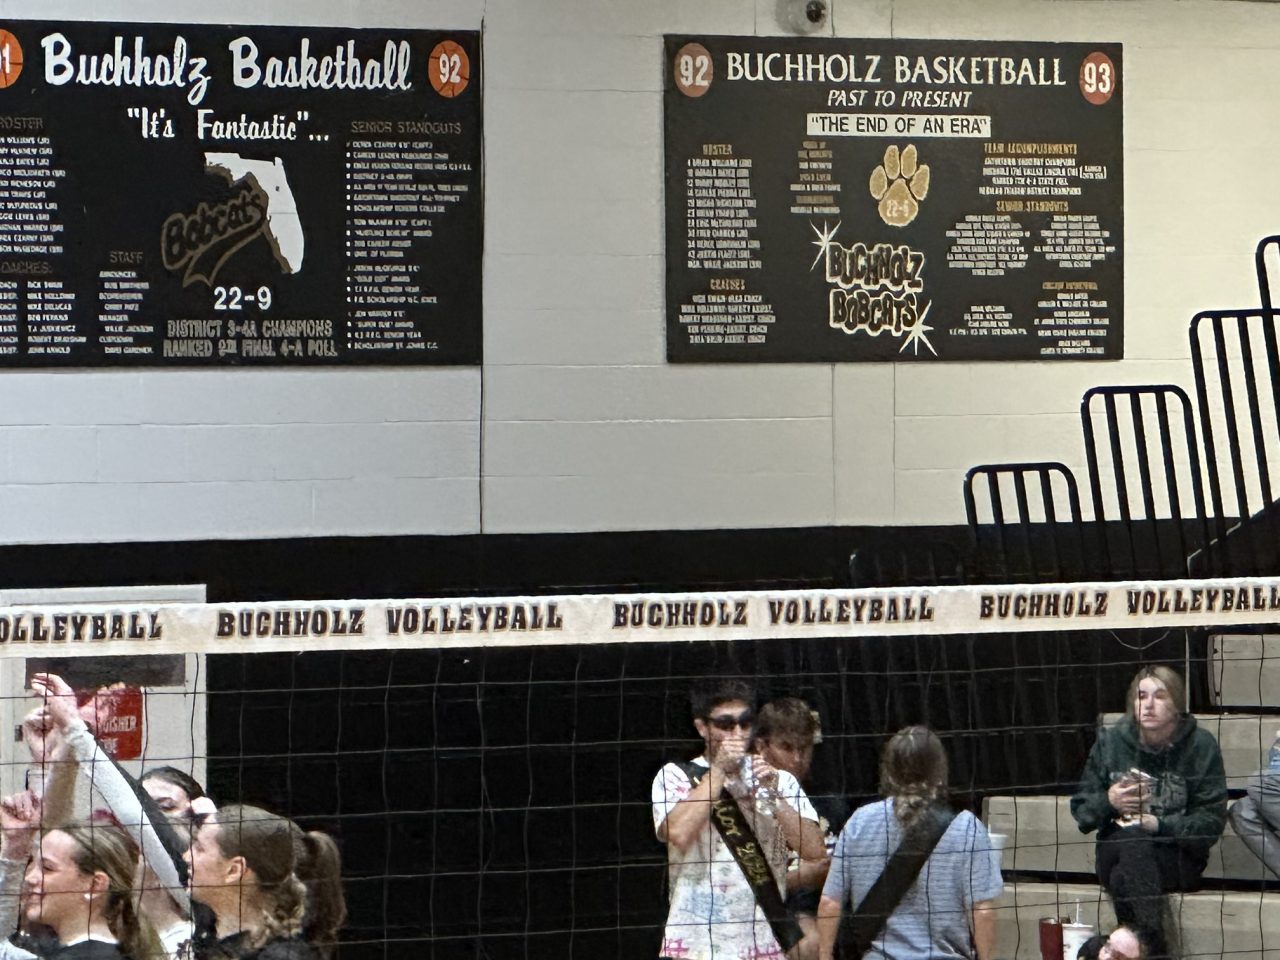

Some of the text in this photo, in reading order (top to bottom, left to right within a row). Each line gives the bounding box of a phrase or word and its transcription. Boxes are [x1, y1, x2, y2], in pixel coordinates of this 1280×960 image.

[40, 33, 411, 104] Buchholz Basketball
[439, 53, 463, 84] 92
[679, 54, 709, 86] 92
[726, 52, 1066, 87] BUCHHOLZ BASKETBALL
[1083, 62, 1111, 94] 93
[827, 90, 972, 108] PAST TO PRESENT
[127, 106, 175, 139] "It's
[811, 115, 987, 135] "THE END OF AN ERA"
[826, 242, 924, 292] BUCHHOLZ
[214, 286, 272, 310] 22-9
[830, 289, 917, 336] BOBCATS
[167, 320, 222, 337] DISTRICT
[262, 320, 333, 338] CHAMPIONS
[216, 608, 364, 640] BUCHHOLZ
[386, 603, 564, 635] VOLLEYBALL
[612, 601, 749, 629] BUCHHOLZ
[769, 596, 935, 625] VOLLEYBALL
[980, 591, 1108, 619] BUCHHOLZ
[1127, 585, 1280, 615] VOLLEYBALL
